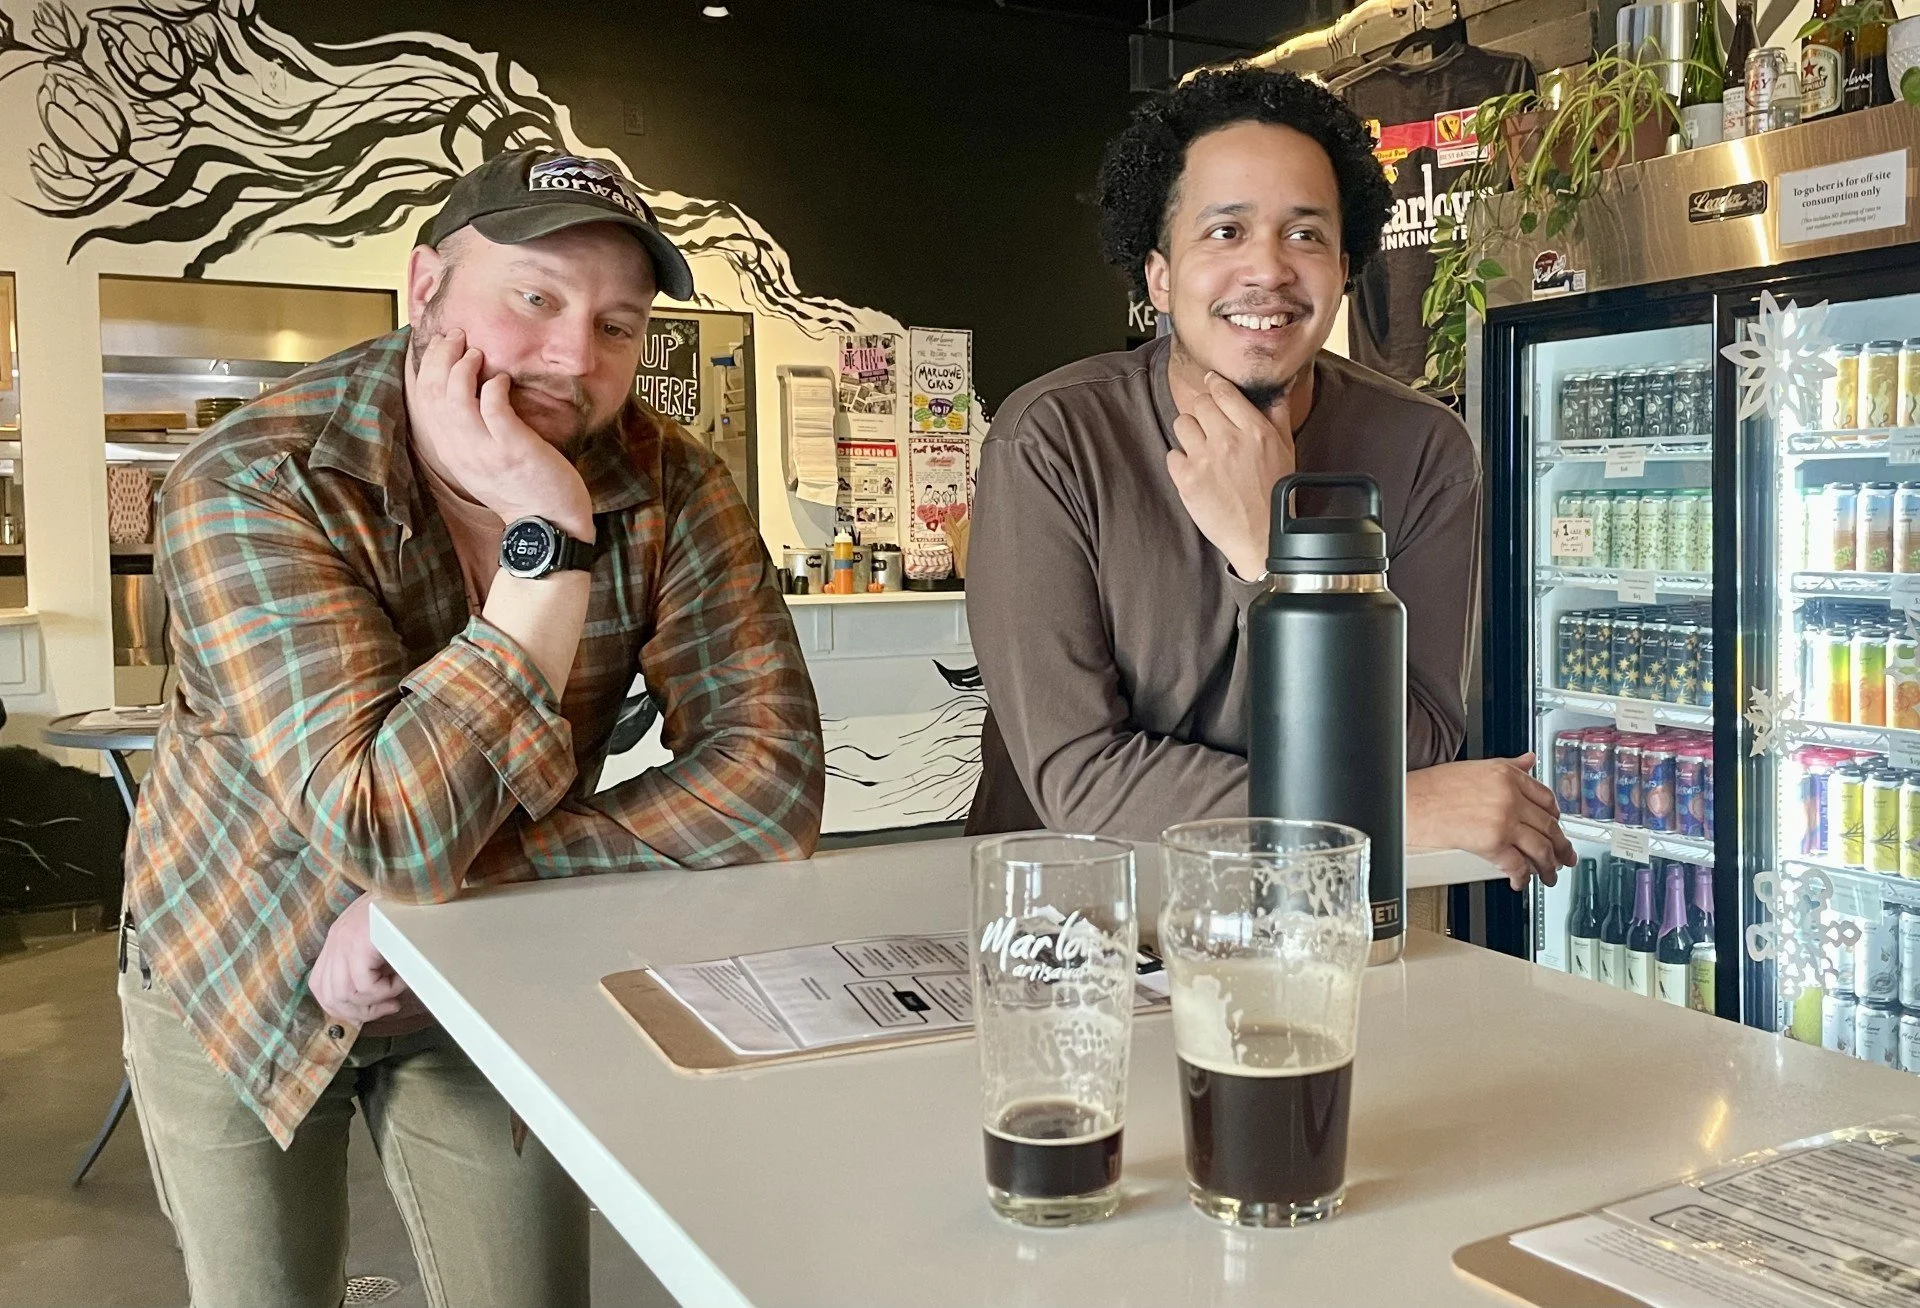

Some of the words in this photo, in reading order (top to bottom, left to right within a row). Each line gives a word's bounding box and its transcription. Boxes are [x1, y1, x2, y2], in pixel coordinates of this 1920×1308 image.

[1816, 183, 1835, 193] beer
[1836, 180, 1844, 189] is
[1845, 177, 1859, 187] for
[1802, 191, 1859, 208] consumption
[1860, 185, 1881, 198] only
[1129, 300, 1158, 332] KE
[641, 334, 679, 371] UP
[919, 366, 962, 381] MARLOWE
[928, 380, 954, 390] GRAS
[636, 375, 698, 416] HERE
[837, 447, 894, 457] CHOKING
[516, 539, 528, 555] 40
[527, 540, 539, 556] 16
[980, 909, 1092, 973] Marlo
